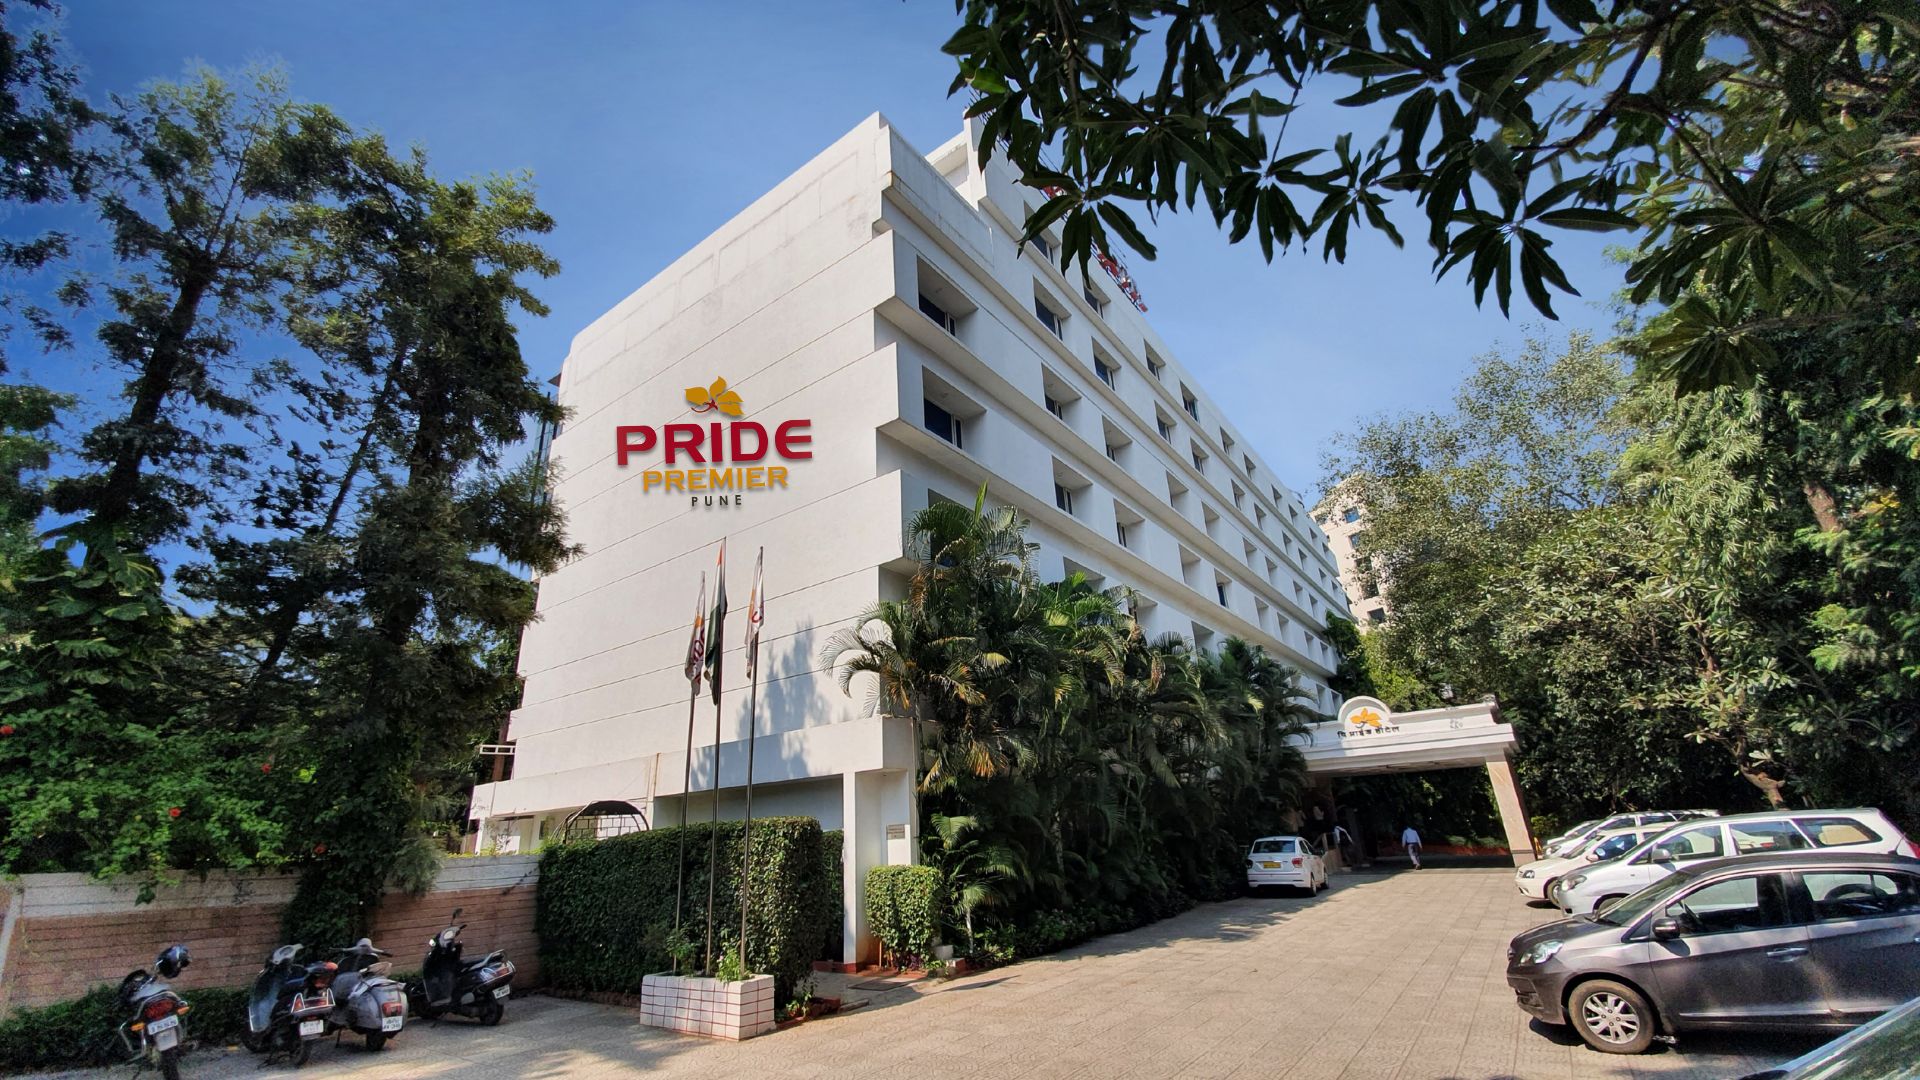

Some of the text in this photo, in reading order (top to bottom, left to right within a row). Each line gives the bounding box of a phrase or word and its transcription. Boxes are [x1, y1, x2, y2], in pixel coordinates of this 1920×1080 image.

[616, 419, 813, 466] PRIDE
[642, 466, 788, 492] PREMIER
[691, 494, 742, 507] PUNE
